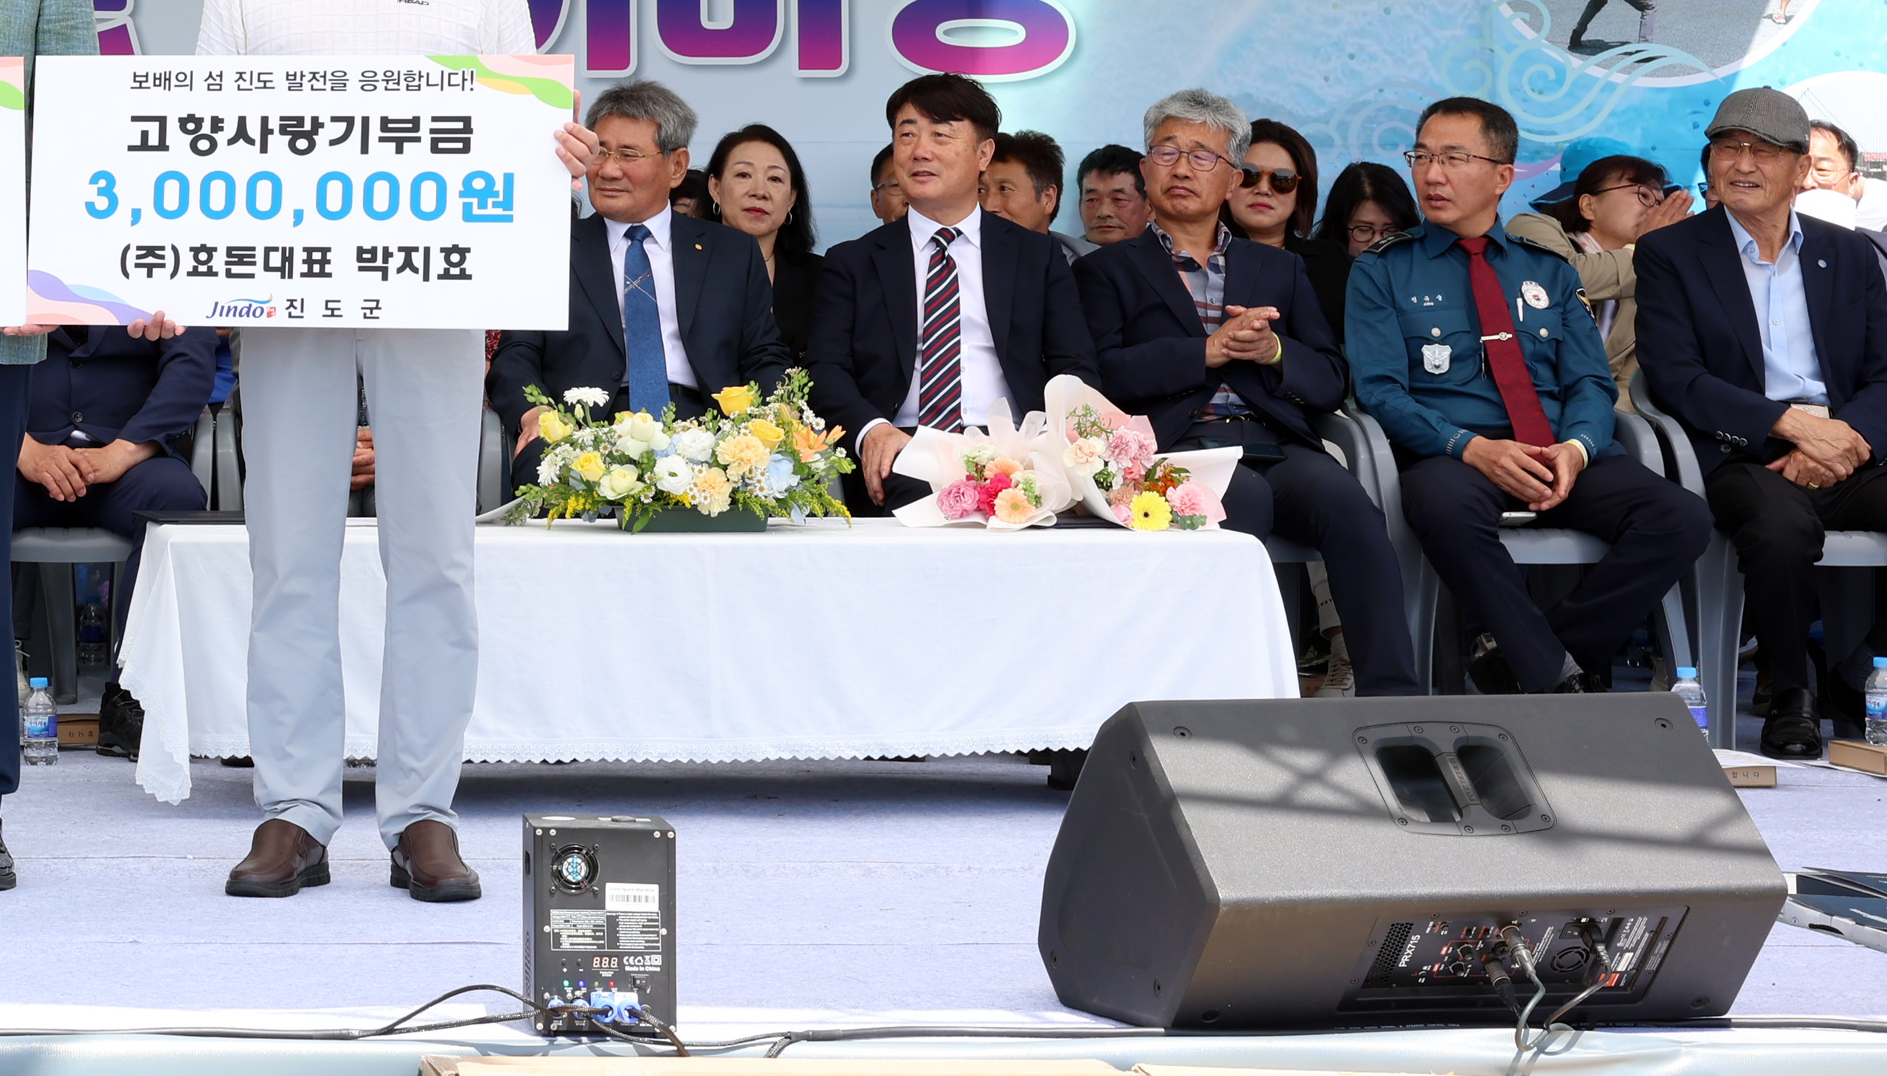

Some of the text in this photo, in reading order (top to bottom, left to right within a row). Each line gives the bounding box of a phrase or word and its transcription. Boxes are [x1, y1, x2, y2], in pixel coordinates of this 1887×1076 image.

[131, 68, 473, 91] 보배의 섬 진도 발전을 응원합니다!
[128, 114, 473, 156] 고향사랑기부금
[86, 171, 514, 226] 3,000,000원
[121, 244, 472, 282] (주)효돈대표 박지효
[206, 301, 264, 319] Jindo
[1731, 770, 1760, 779] 합니다
[1399, 934, 1421, 968] PRX715
